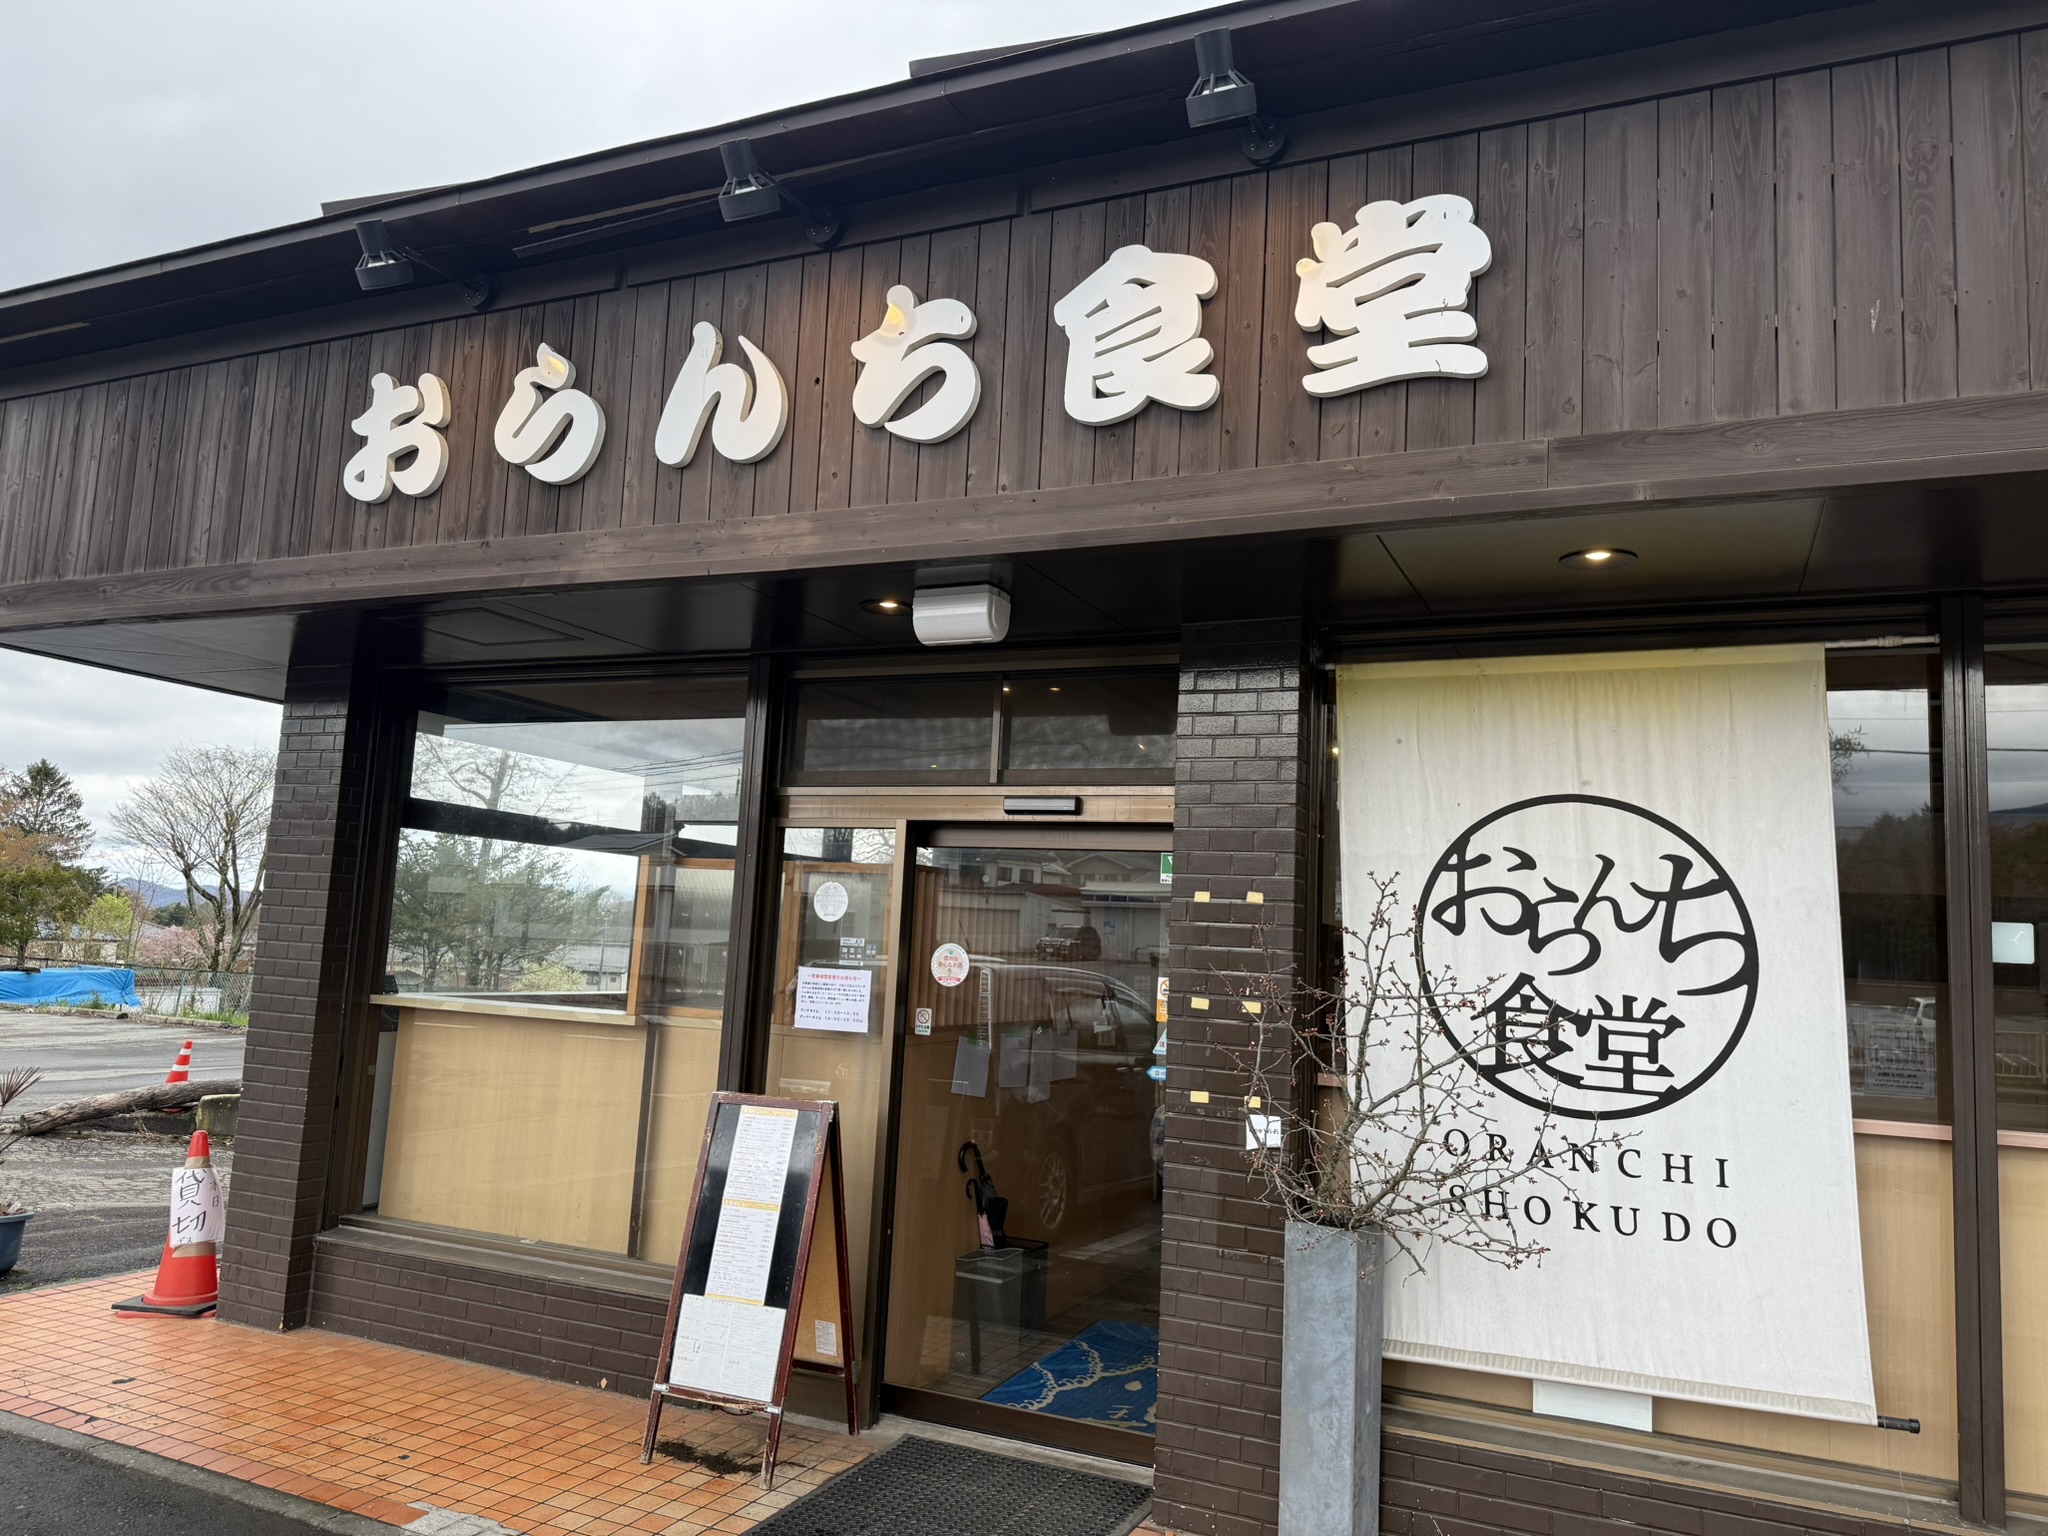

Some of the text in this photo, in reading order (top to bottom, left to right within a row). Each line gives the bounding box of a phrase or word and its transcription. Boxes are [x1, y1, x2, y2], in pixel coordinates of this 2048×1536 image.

[343, 194, 1492, 505] おらんち食堂
[1430, 837, 1752, 996] おらんち
[1470, 971, 1686, 1098] 食堂
[172, 1168, 207, 1234] 貸切
[1442, 1128, 1730, 1188] ORANCHI
[1447, 1184, 1737, 1248] SHOKUDO
